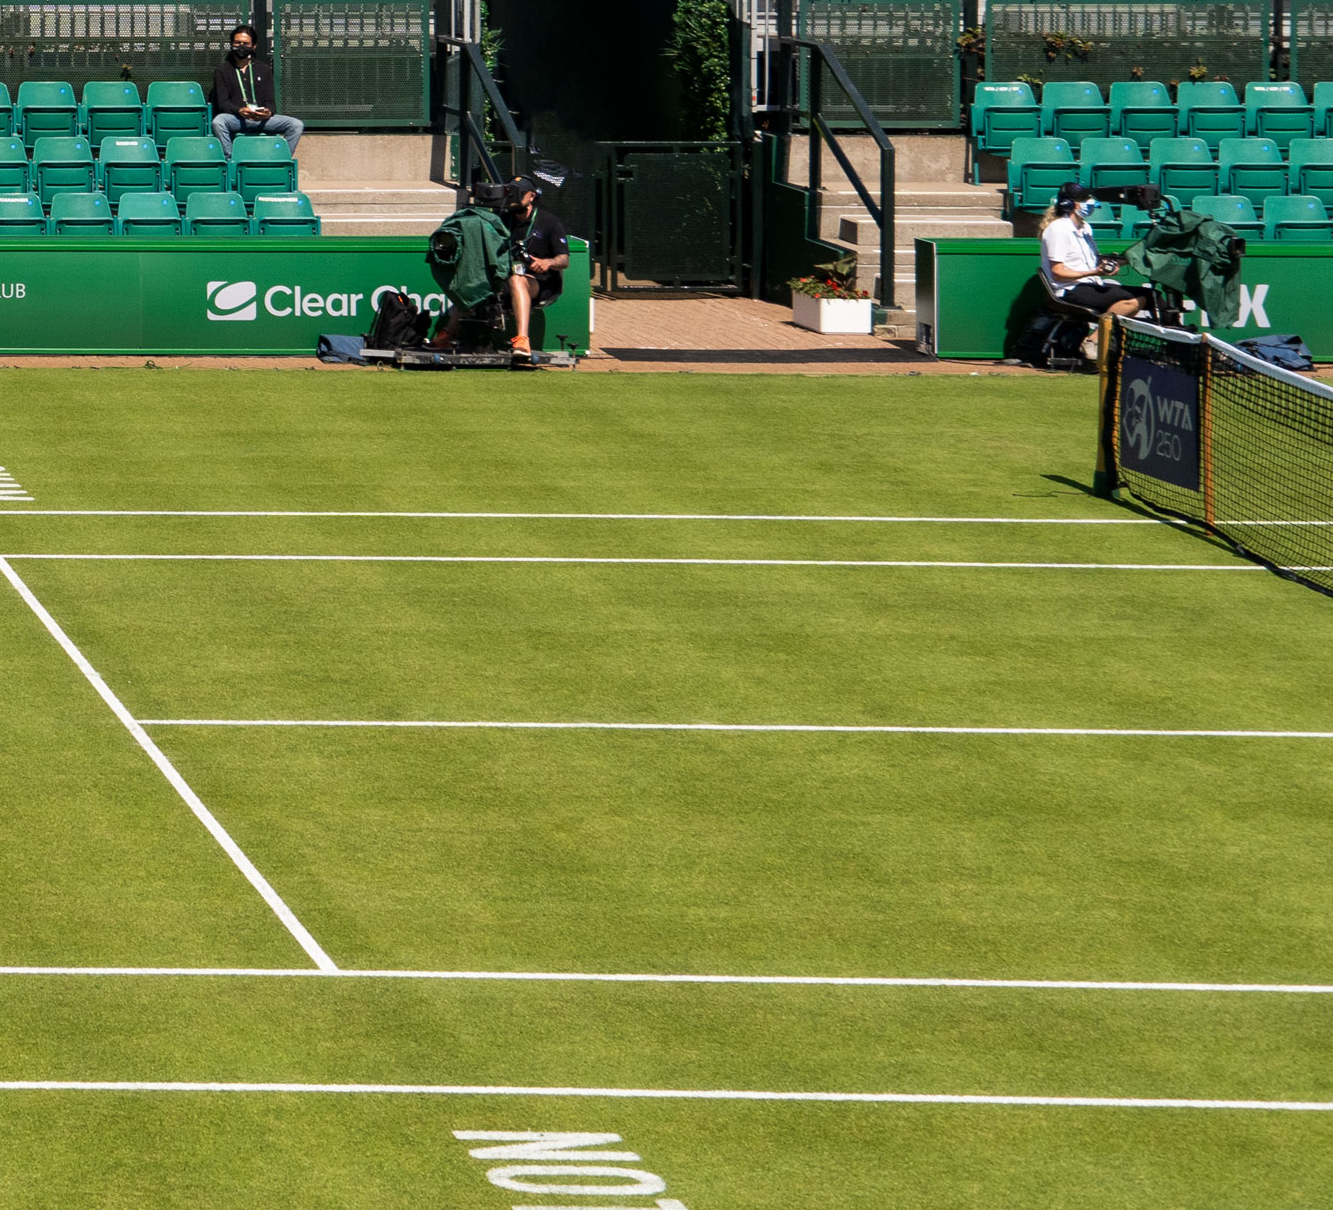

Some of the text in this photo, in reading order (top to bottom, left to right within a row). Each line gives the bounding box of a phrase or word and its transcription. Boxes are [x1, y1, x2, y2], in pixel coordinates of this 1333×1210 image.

[264, 285, 363, 317] Clear
[1156, 395, 1192, 431] WTA
[1156, 430, 1181, 461] 250
